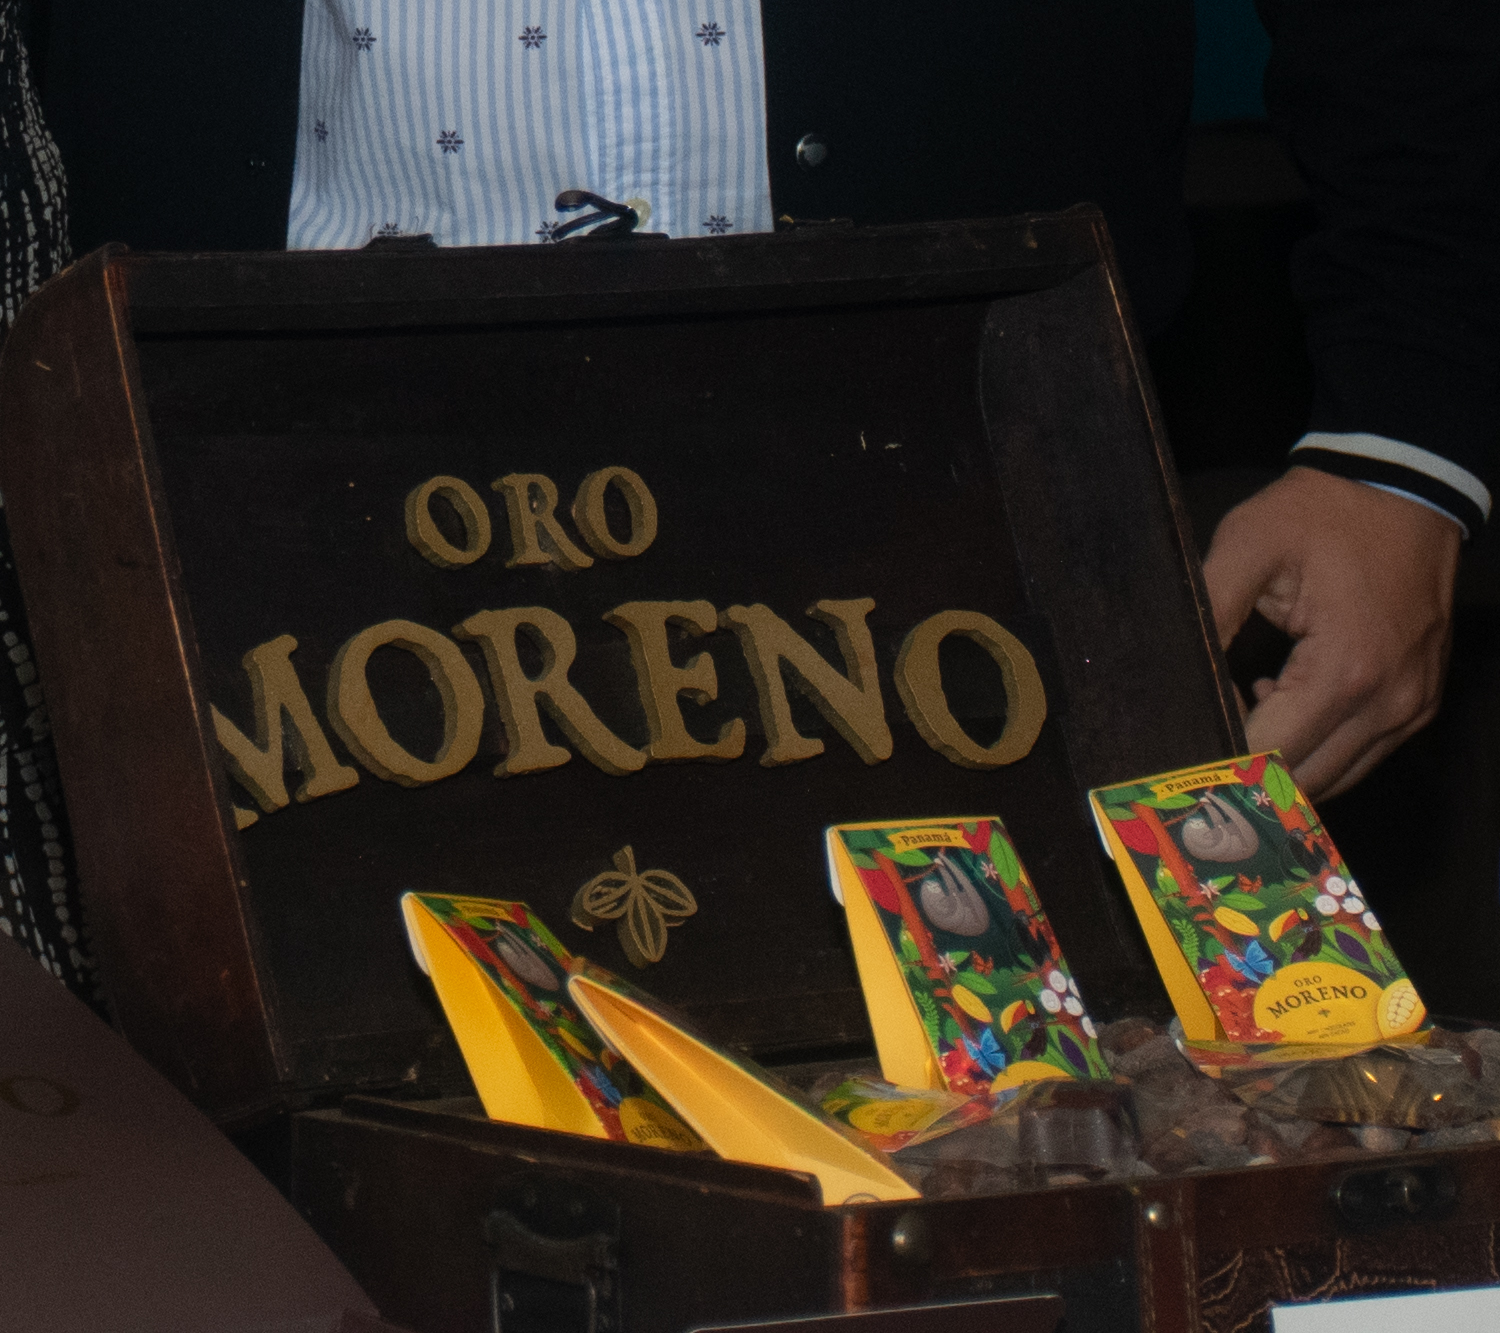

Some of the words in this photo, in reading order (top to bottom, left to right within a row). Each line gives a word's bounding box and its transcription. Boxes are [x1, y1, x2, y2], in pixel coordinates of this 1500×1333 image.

[405, 465, 659, 571] ORO
[209, 597, 1049, 833] MORENO
[1165, 771, 1222, 793] Panamá
[901, 832, 952, 847] Panamá
[1294, 975, 1322, 988] ORO
[1267, 984, 1368, 1020] MORENO
